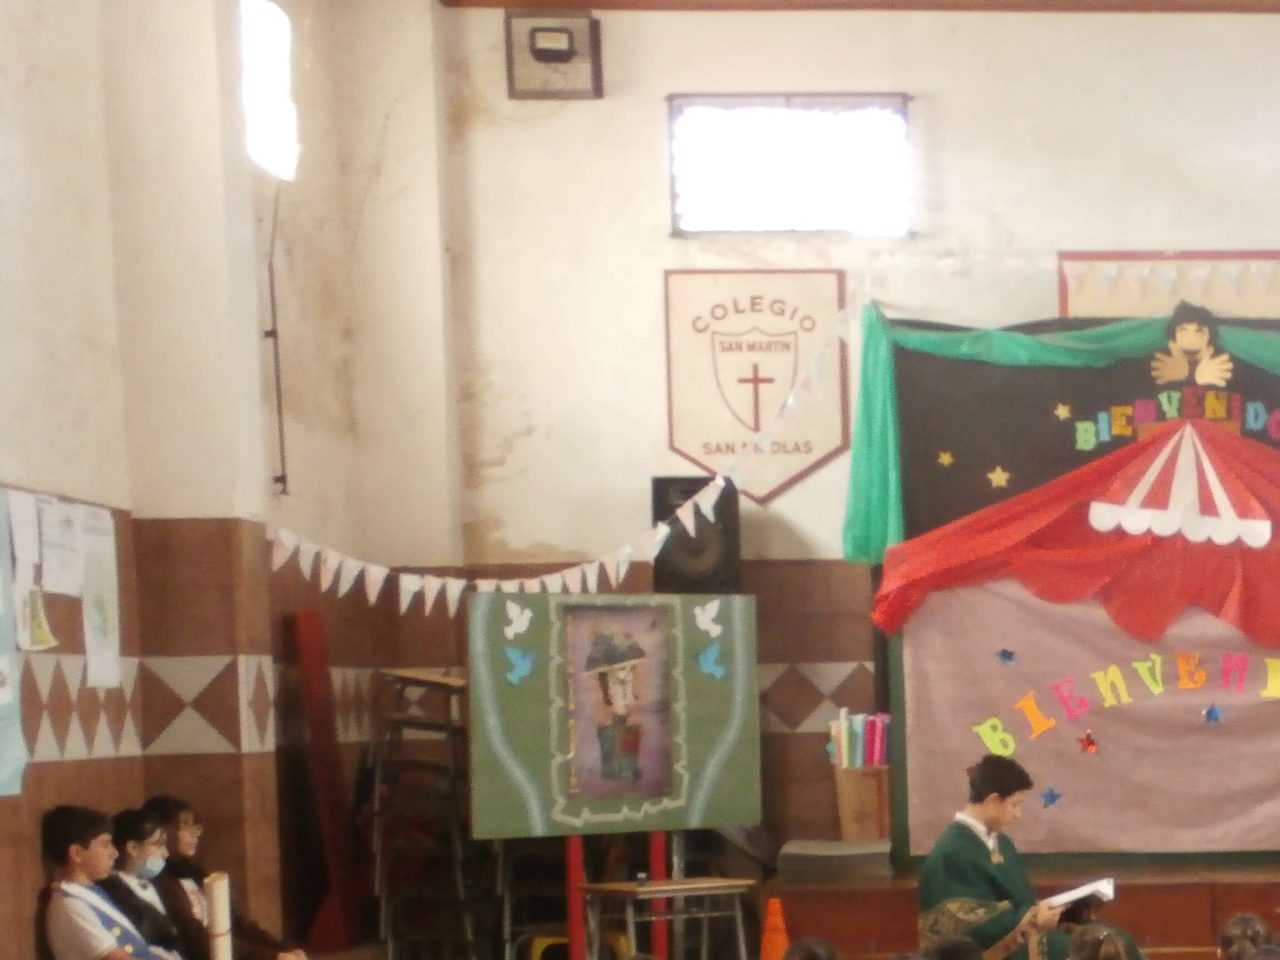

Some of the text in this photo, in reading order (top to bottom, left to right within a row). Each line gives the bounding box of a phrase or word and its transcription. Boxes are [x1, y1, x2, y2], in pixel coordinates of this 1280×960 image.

[692, 295, 816, 333] COLEGIO
[719, 341, 743, 352] SAN
[702, 441, 813, 455] SAN OLAS
